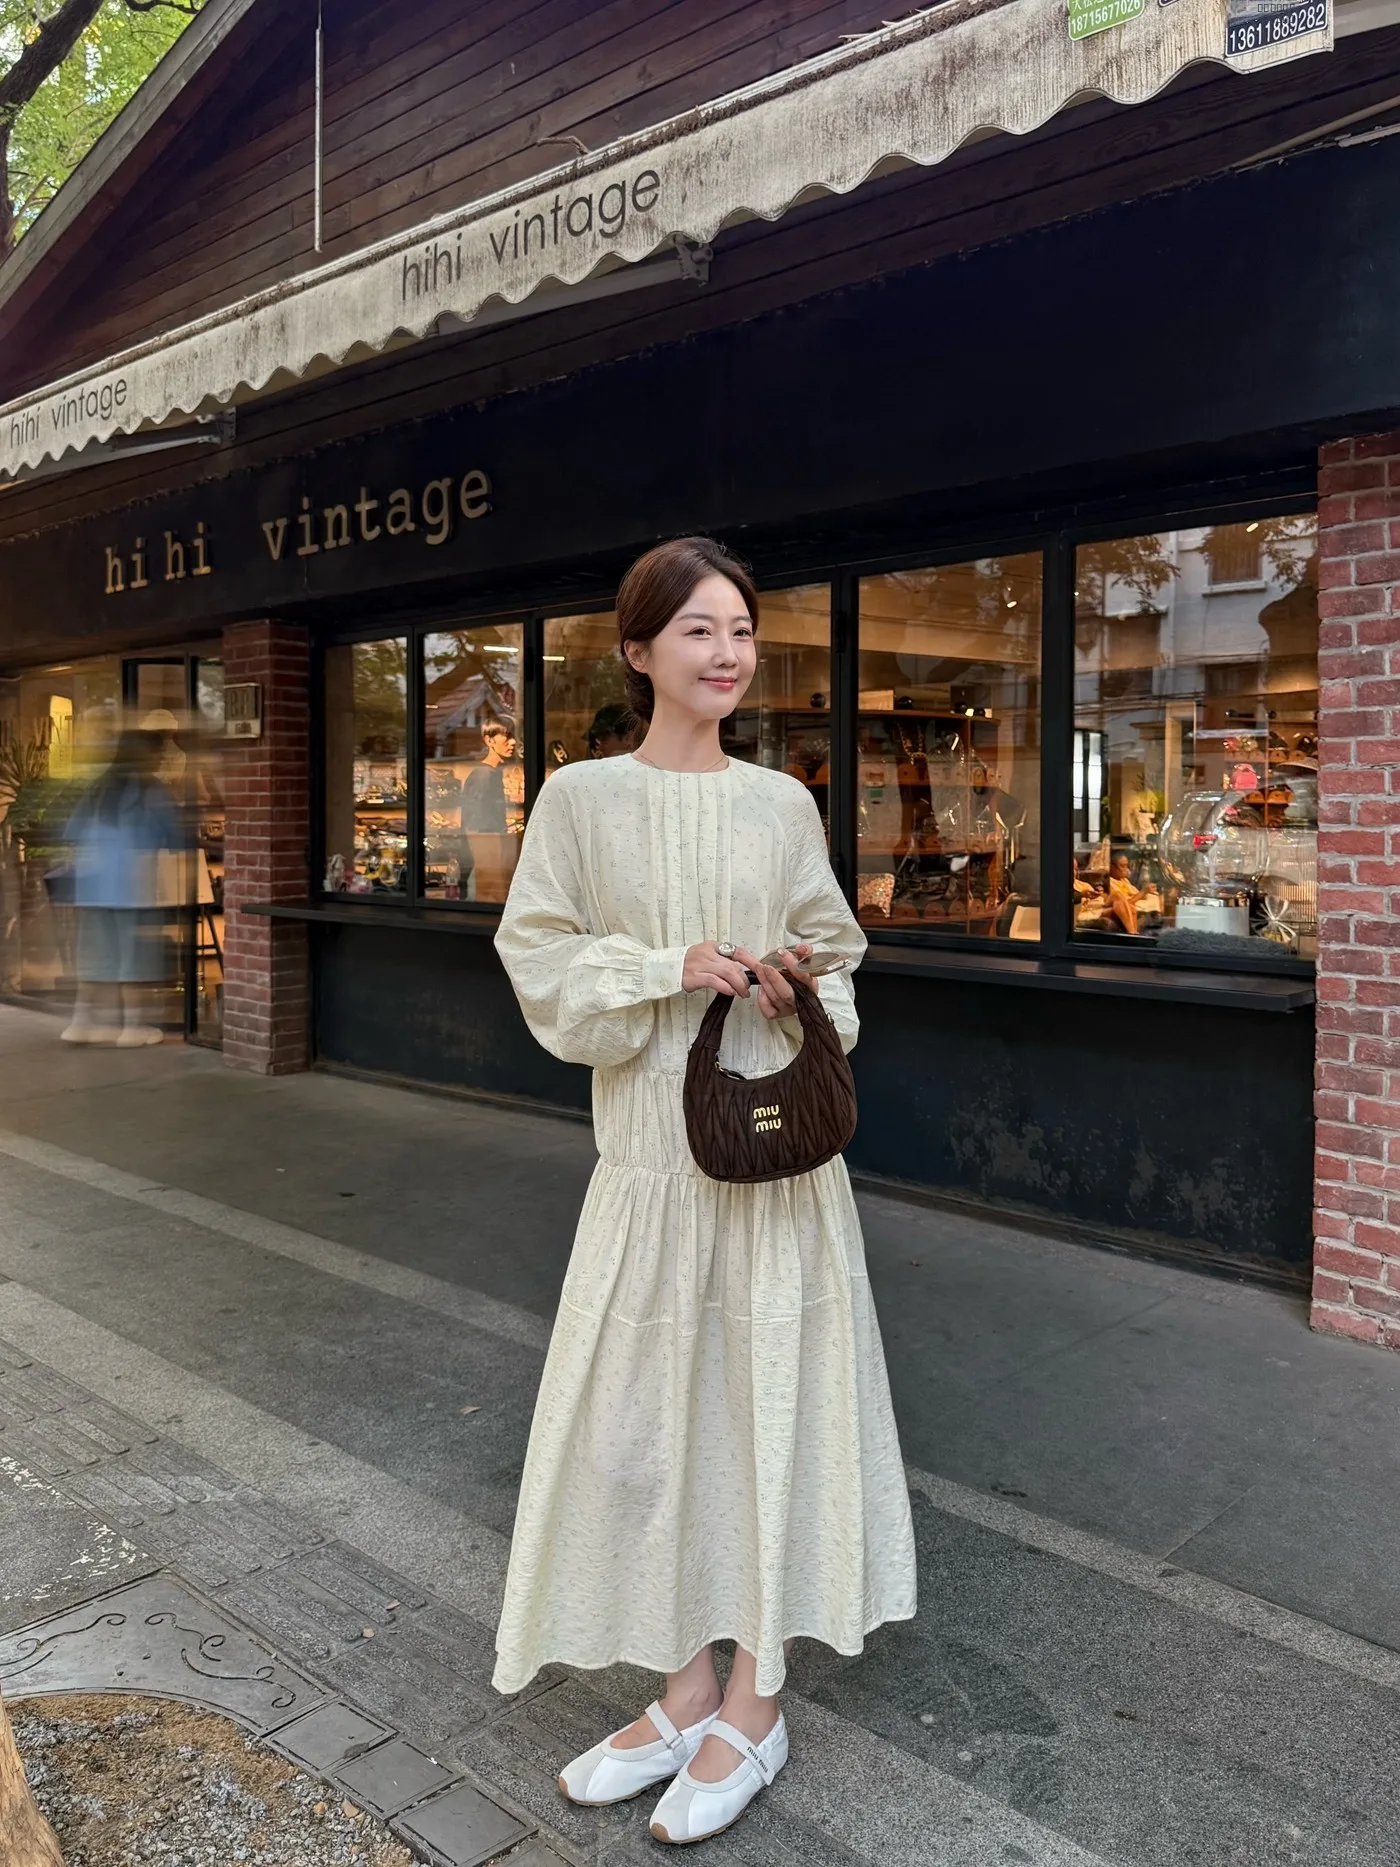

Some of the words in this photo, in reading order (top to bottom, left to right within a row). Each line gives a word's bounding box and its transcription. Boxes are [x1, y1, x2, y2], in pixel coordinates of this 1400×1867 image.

[1230, 3, 1325, 52] 13611889282
[402, 232, 463, 301] hihi
[489, 169, 661, 266] vintage
[11, 406, 41, 449] hihi
[52, 379, 127, 431] vintage
[262, 469, 492, 560] vintage
